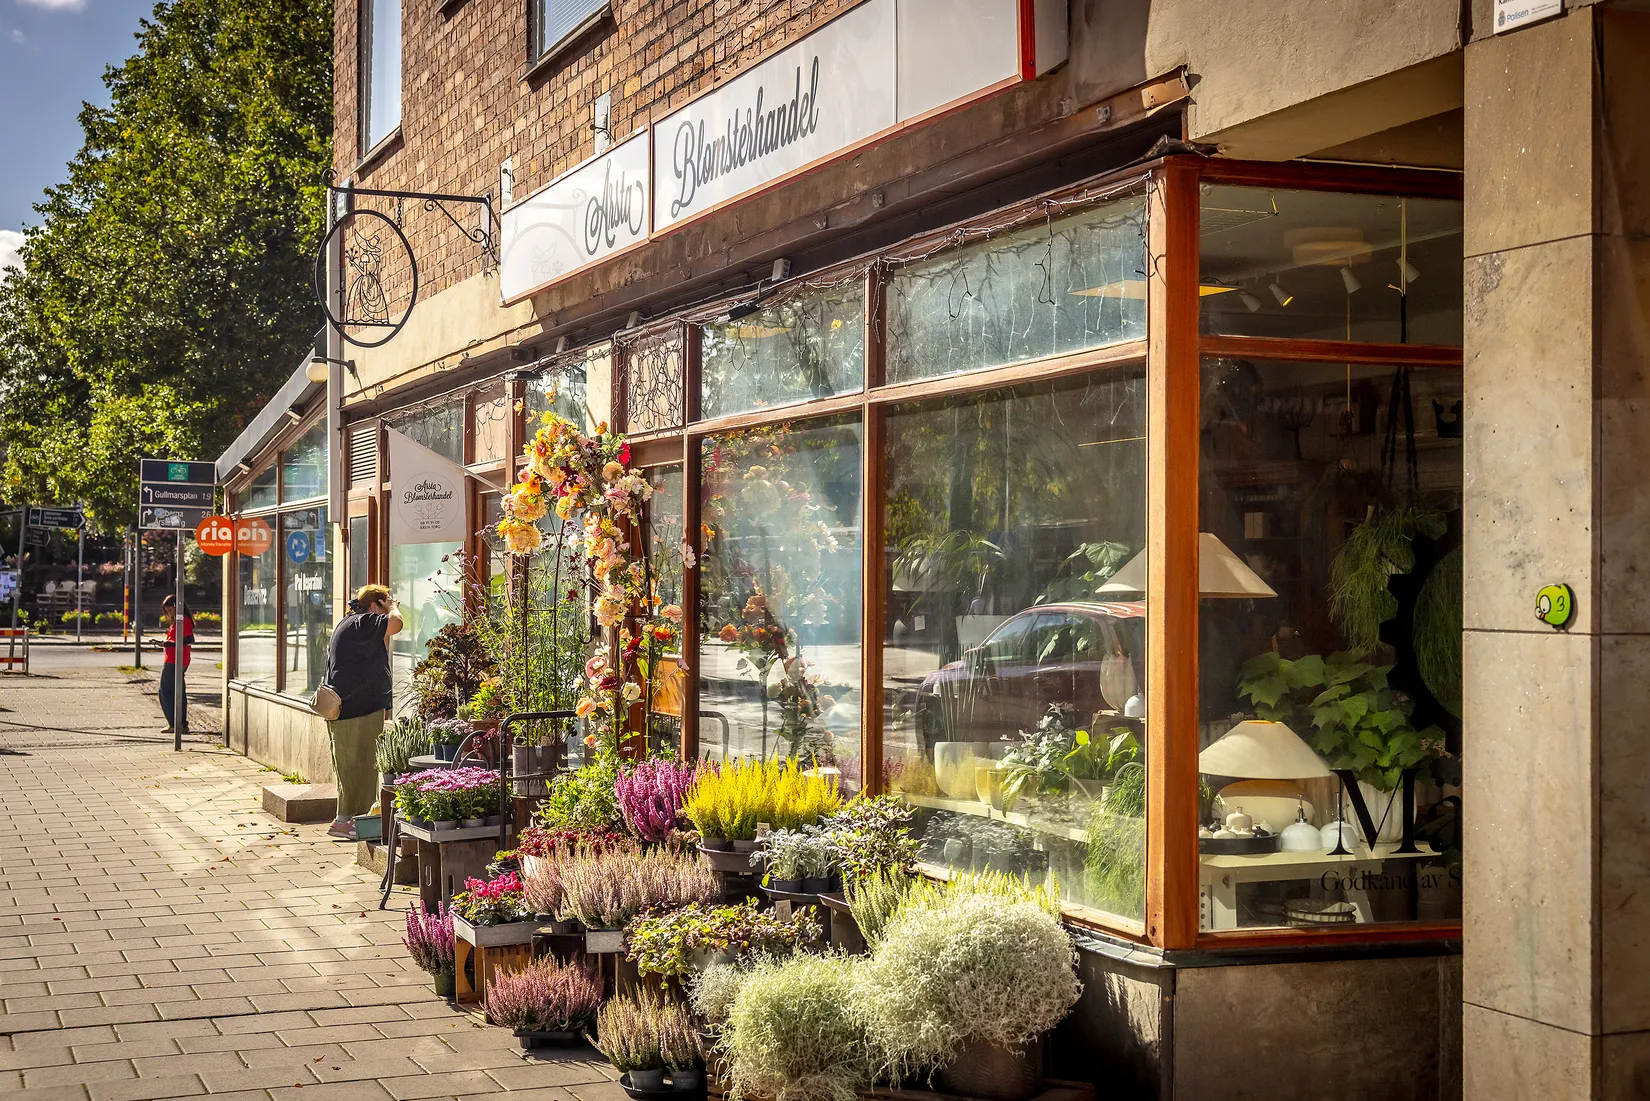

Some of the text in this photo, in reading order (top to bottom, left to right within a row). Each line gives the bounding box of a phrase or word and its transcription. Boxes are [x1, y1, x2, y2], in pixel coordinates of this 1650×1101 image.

[1507, 9, 1529, 22] Polisen
[671, 55, 820, 218] Blomsterhandel
[154, 490, 198, 501] Gullmarsplan
[403, 491, 453, 504] Blomsterhandel
[200, 520, 232, 541] ria
[1421, 874, 1443, 889] av
